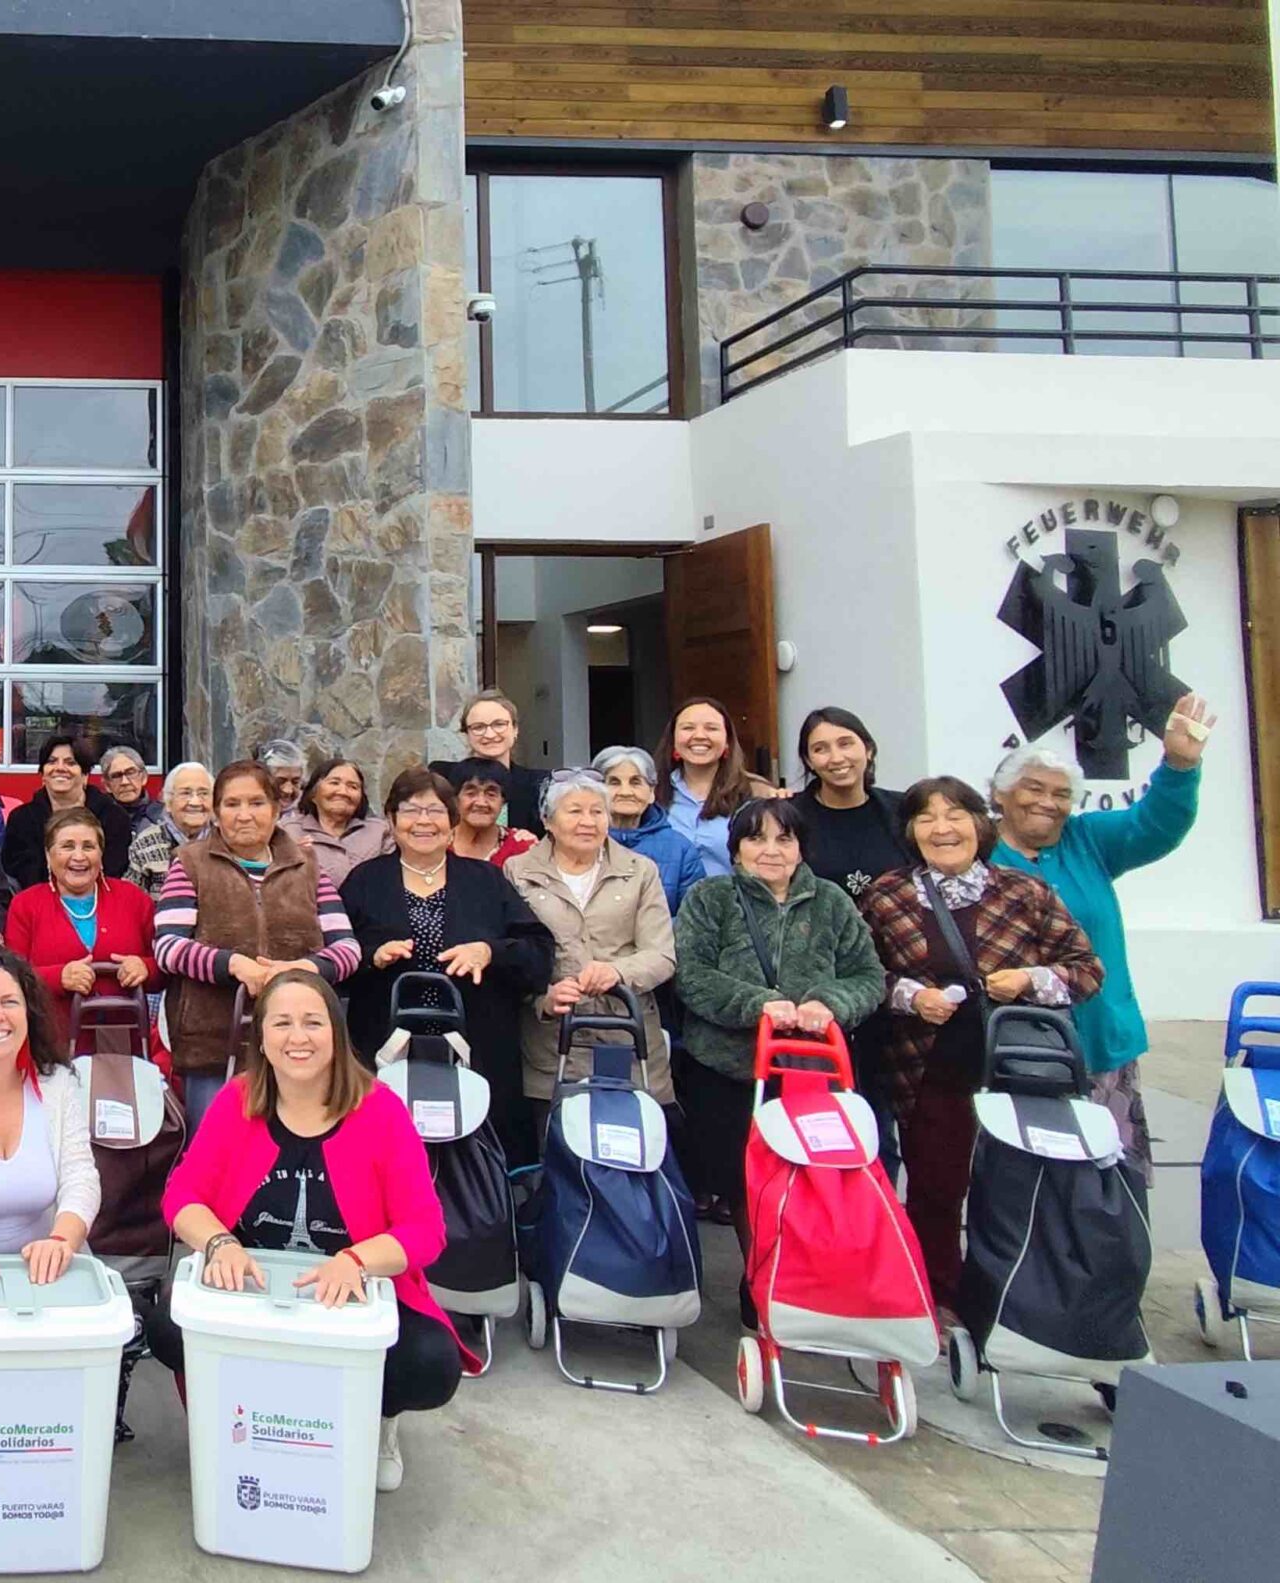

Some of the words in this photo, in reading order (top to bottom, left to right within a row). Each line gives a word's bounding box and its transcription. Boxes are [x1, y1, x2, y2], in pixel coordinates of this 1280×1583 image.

[1006, 498, 1181, 567] FEUERWEHR
[252, 1411, 334, 1430] EcoMercados
[252, 1425, 314, 1441] Solidarios
[263, 1491, 296, 1502] PUERTO
[297, 1495, 327, 1505] VARAS
[36, 1502, 64, 1510] VARAS
[263, 1500, 294, 1511] SOMOS
[296, 1503, 327, 1515] TOD@S
[2, 1512, 32, 1520] SOMOS
[34, 1511, 64, 1520] TOD@S
